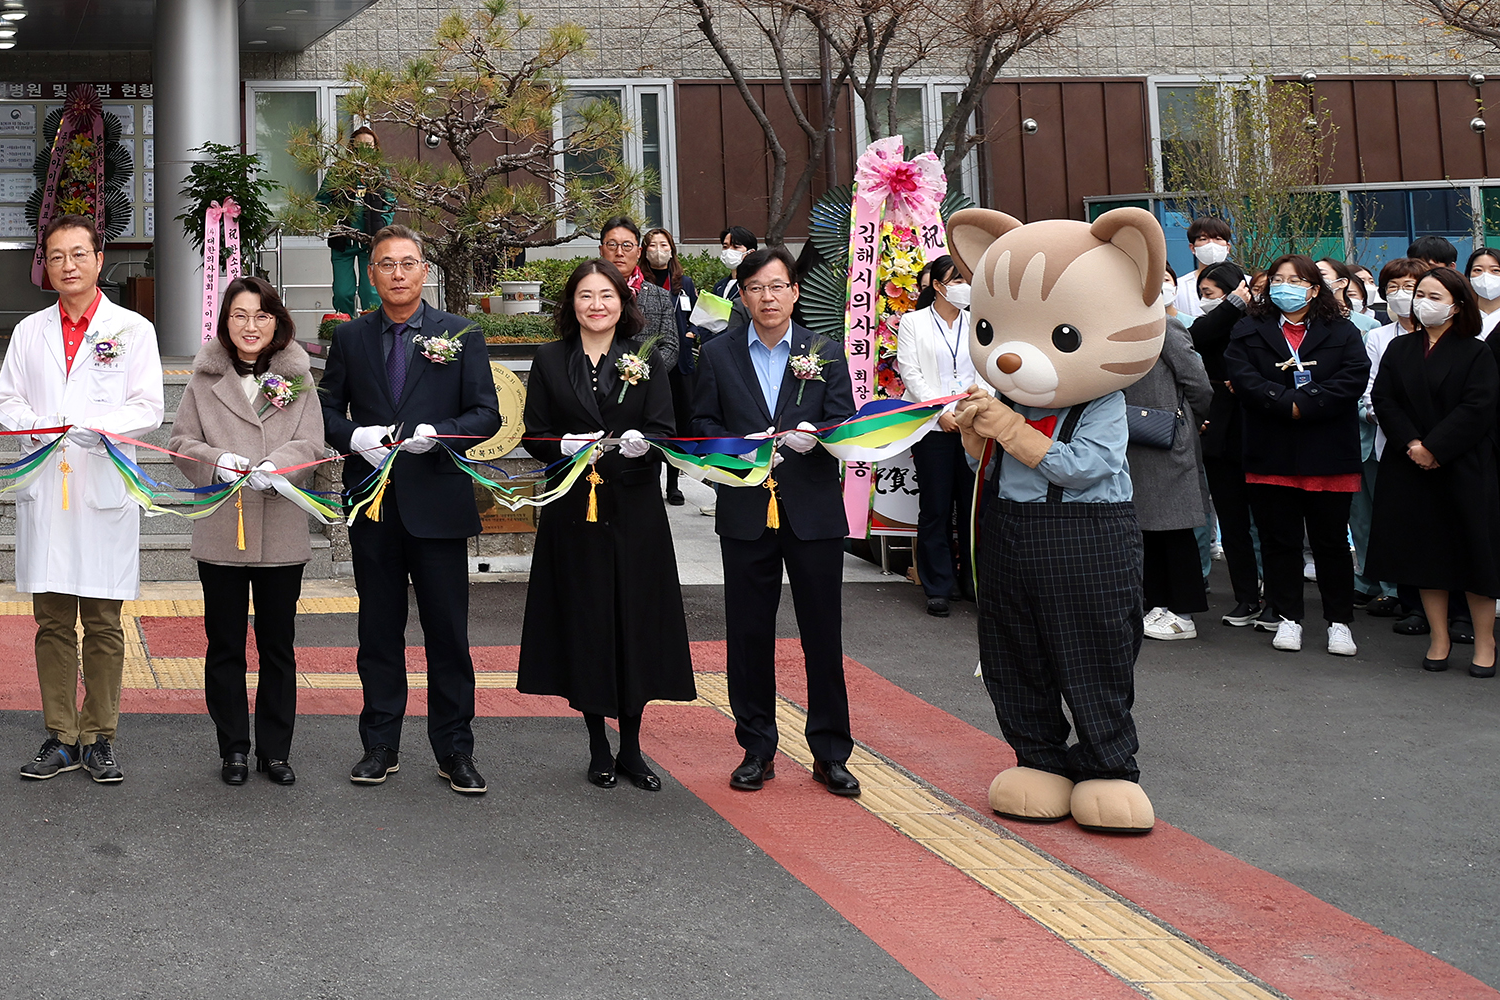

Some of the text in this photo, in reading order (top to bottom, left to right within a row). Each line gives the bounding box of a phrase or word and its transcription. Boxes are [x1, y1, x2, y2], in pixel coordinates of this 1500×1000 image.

[53, 84, 67, 98] 및
[228, 228, 239, 241] 祝
[921, 224, 945, 250] 祝
[850, 221, 875, 400] 김해시의사회 회장
